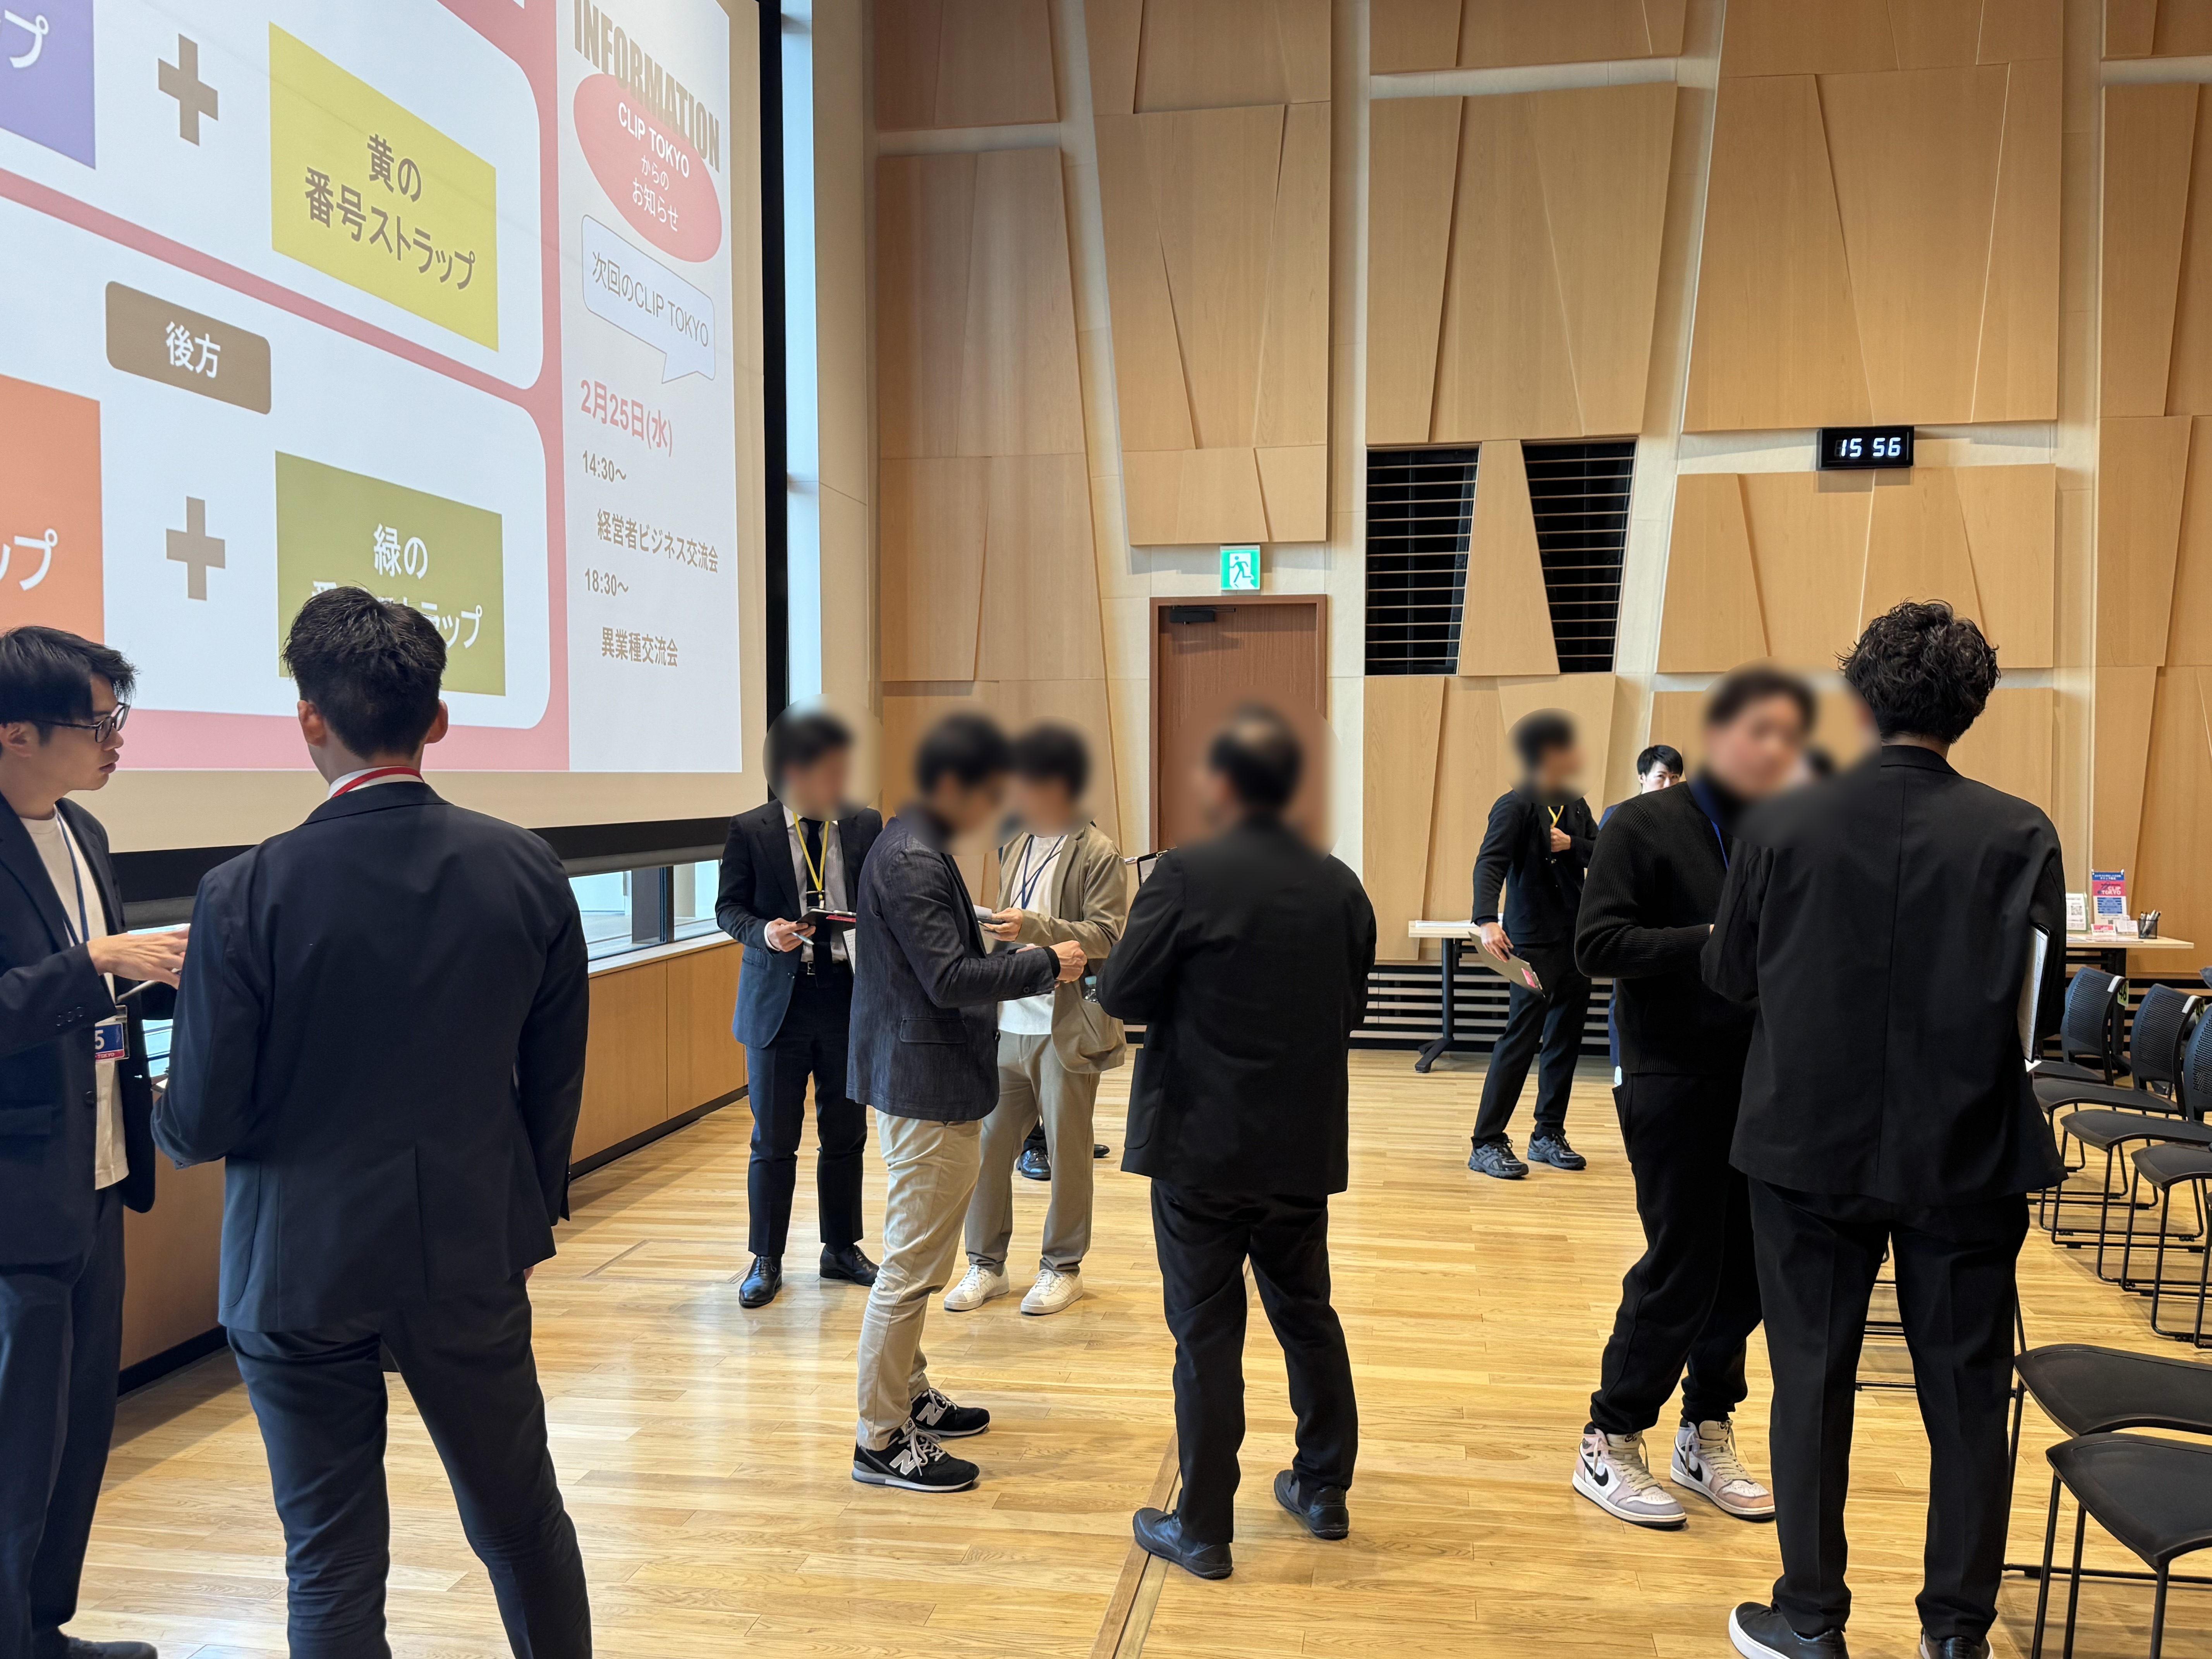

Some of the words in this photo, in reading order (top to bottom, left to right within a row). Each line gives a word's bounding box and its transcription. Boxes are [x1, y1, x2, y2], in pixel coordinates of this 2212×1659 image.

[0, 9, 49, 68] プ
[574, 0, 720, 173] INFORMATION
[367, 134, 422, 203] 黄の
[618, 102, 646, 141] CLIP
[649, 127, 689, 178] TOKYO
[641, 155, 669, 191] からの
[305, 166, 476, 290] 番号ストラップ
[632, 177, 678, 232] お知らせ
[592, 251, 664, 318] 次回のCLIP
[668, 300, 708, 347] TOKYO
[166, 321, 221, 378] 後方
[581, 380, 672, 458] 2月25日(水)
[373, 523, 428, 580] 緑の
[597, 508, 718, 574] 経営者ビジネス交流会
[601, 626, 678, 668] 異業種交流会
